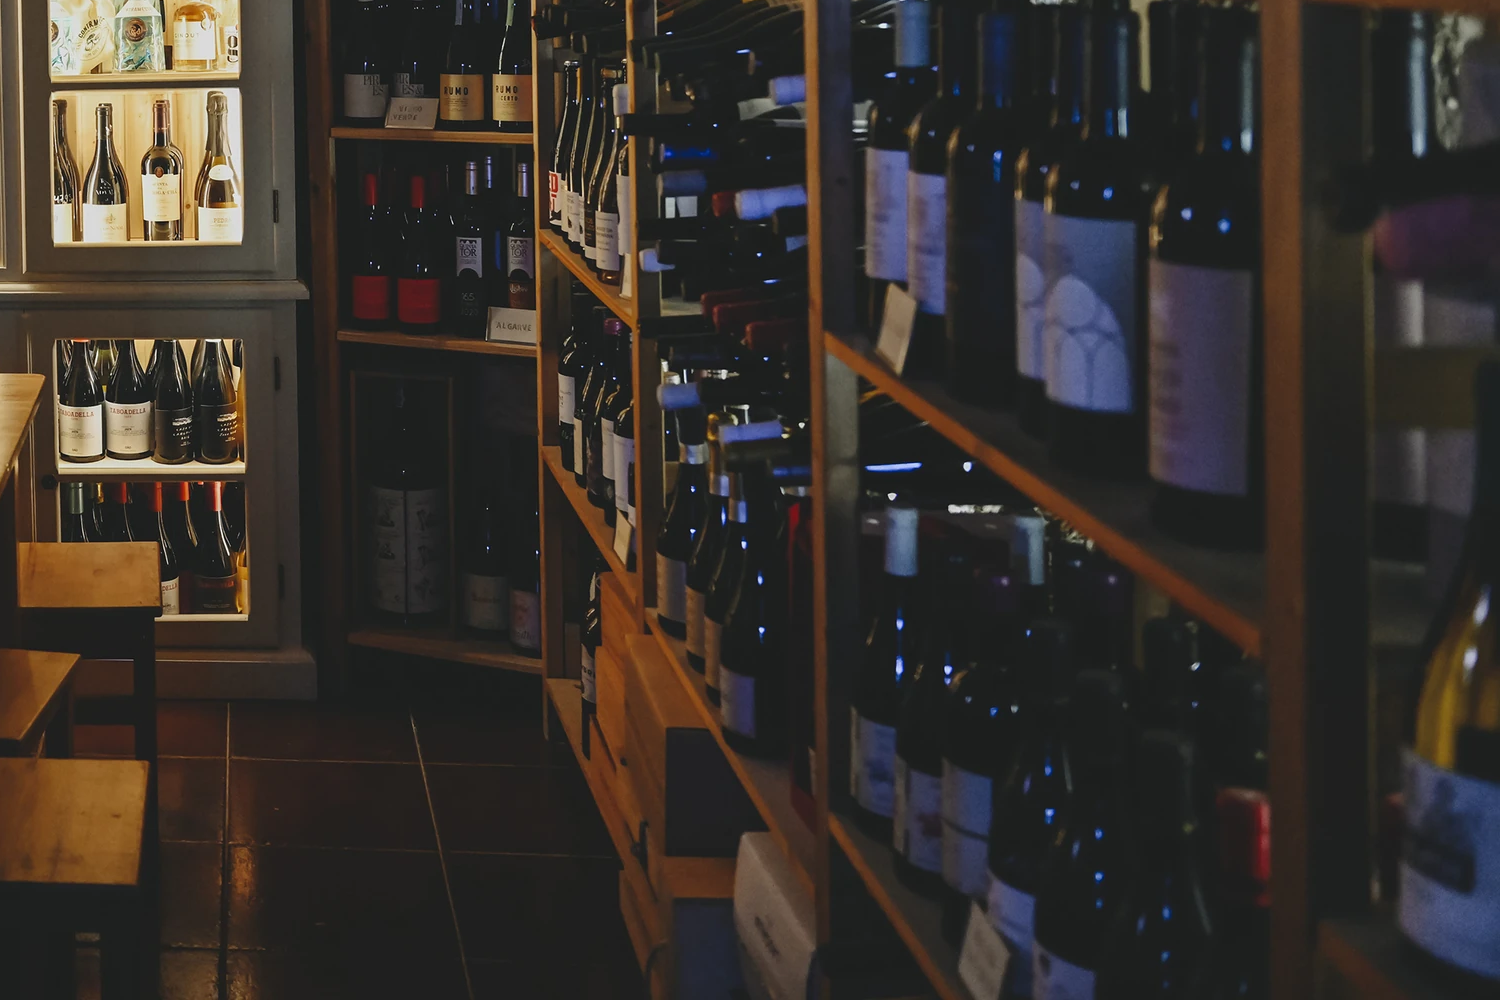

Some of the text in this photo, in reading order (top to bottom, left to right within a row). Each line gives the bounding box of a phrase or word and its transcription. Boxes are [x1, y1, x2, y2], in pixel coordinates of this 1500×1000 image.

[443, 86, 469, 96] RUMO
[495, 85, 518, 94] RUMO
[495, 321, 532, 332] ALGARVE
[110, 407, 146, 415] TABOADELLA
[162, 583, 178, 591] DELLA
